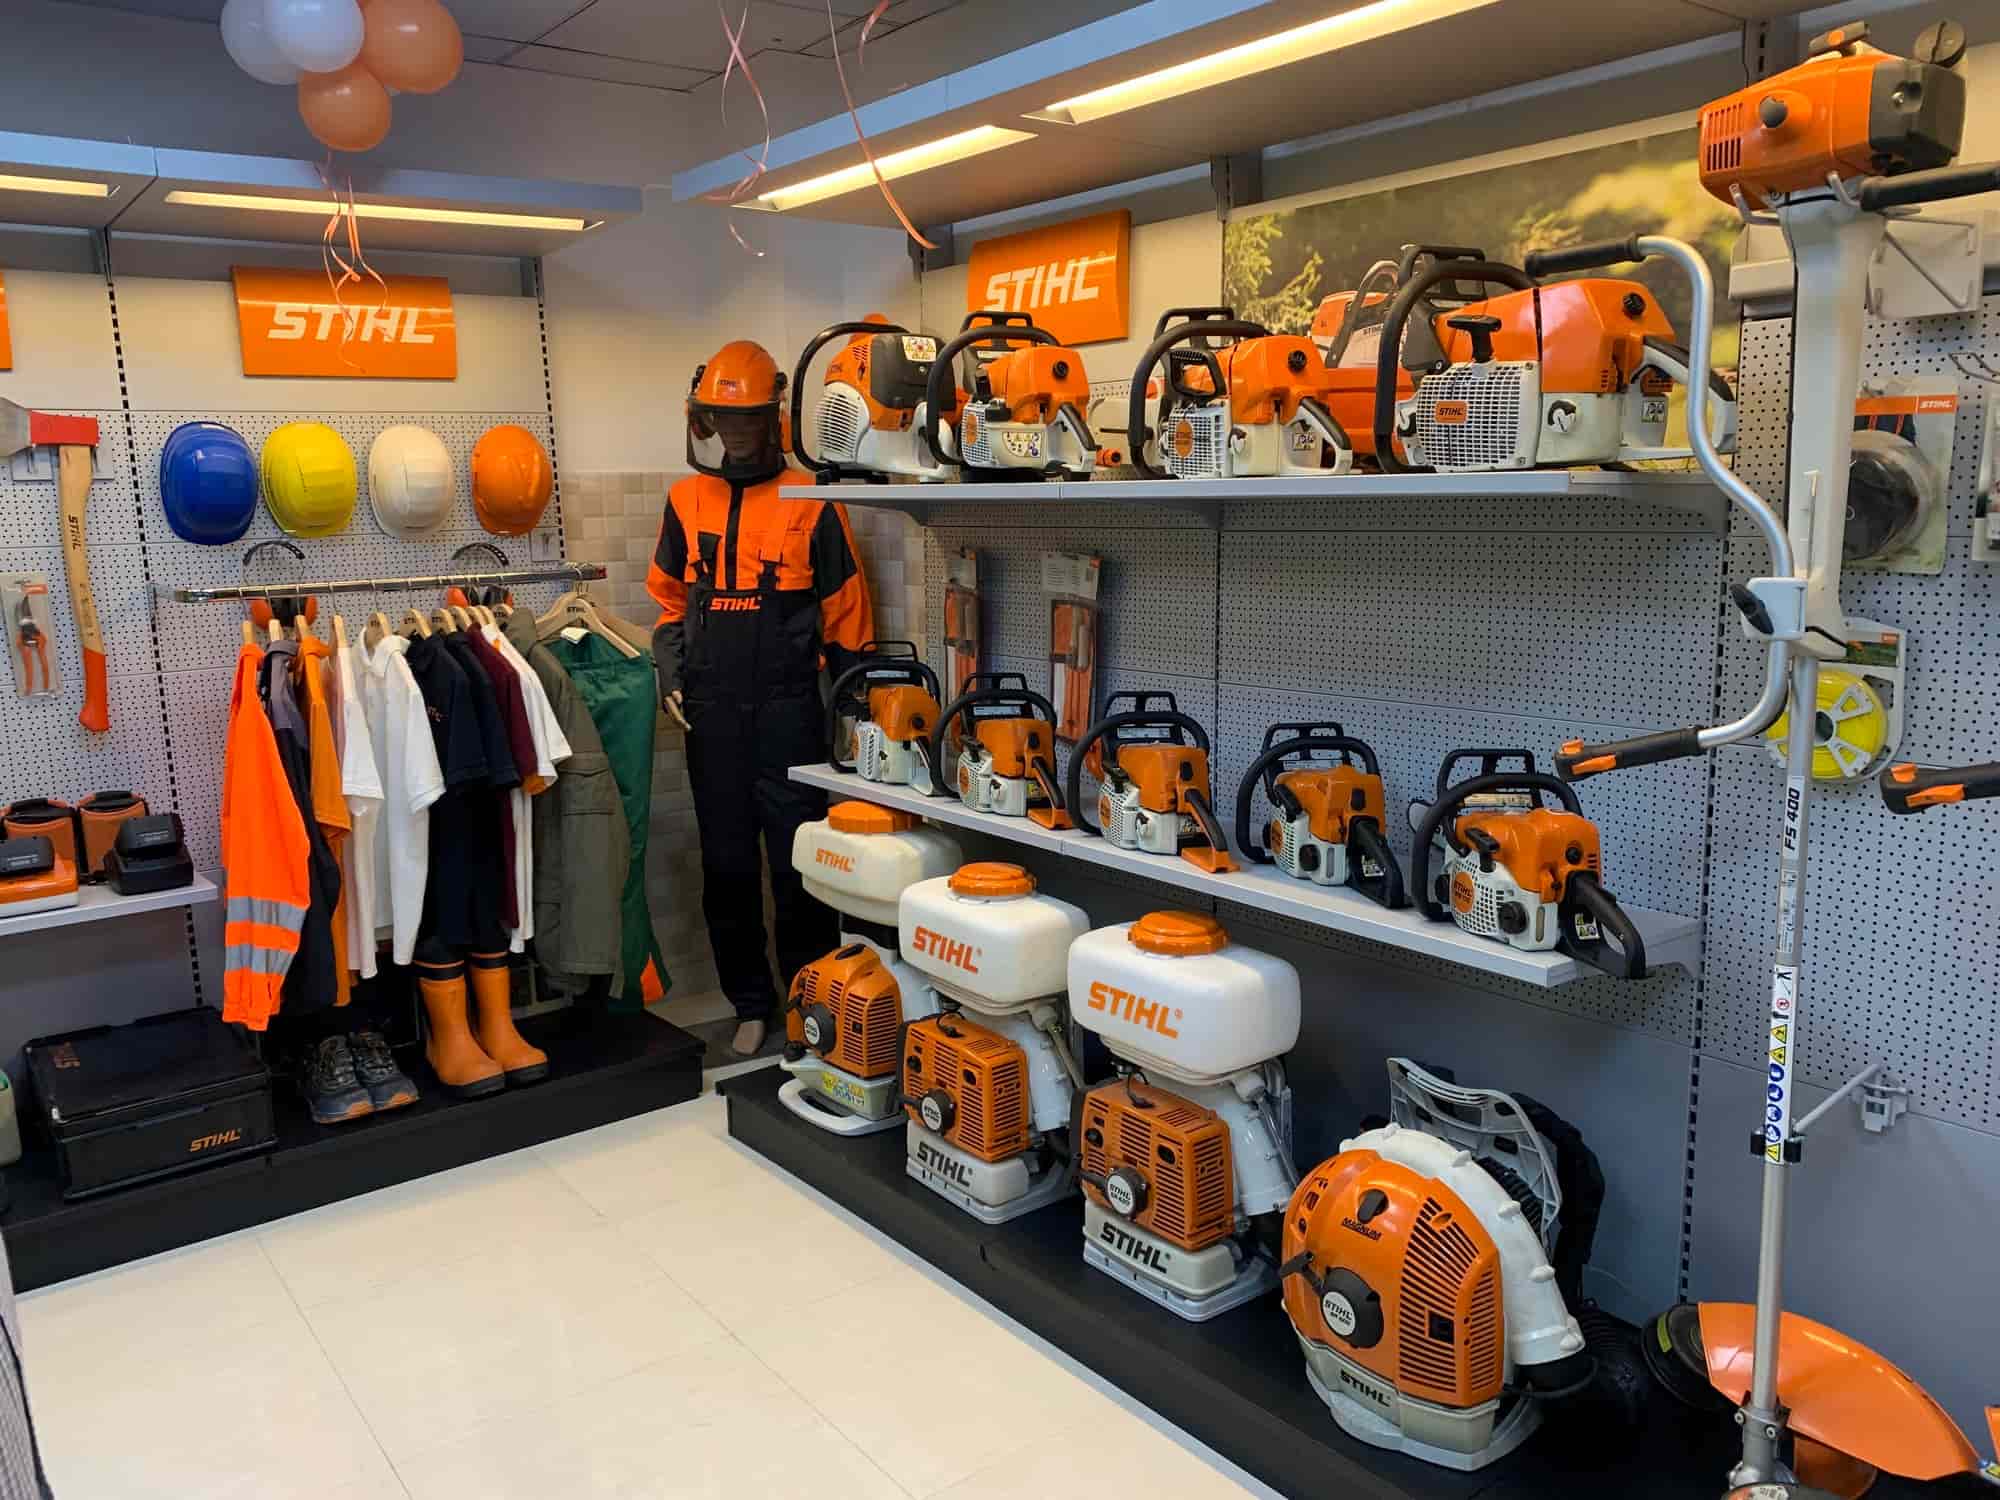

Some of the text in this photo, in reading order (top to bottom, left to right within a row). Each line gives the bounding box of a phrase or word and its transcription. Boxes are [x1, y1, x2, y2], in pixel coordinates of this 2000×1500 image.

[984, 262, 1100, 312] STIHL
[268, 304, 436, 344] STIHL
[1438, 406, 1465, 417] STIHL
[1919, 400, 1954, 409] STIHL
[67, 513, 83, 553] STIHL
[710, 598, 760, 611] STIHL
[1784, 788, 1800, 851] FS 400
[815, 847, 853, 873] STIHL
[912, 925, 979, 975] STIHL
[1088, 980, 1179, 1040] STIHL
[190, 1131, 241, 1153] STIHL
[917, 1140, 972, 1188] STIHL
[1109, 1183, 1131, 1201] STIHL
[1100, 1221, 1168, 1271] STIHL
[1341, 1217, 1382, 1241] MAGNUM
[1325, 1299, 1353, 1322] STIHL
[1339, 1368, 1391, 1408] STIHL
